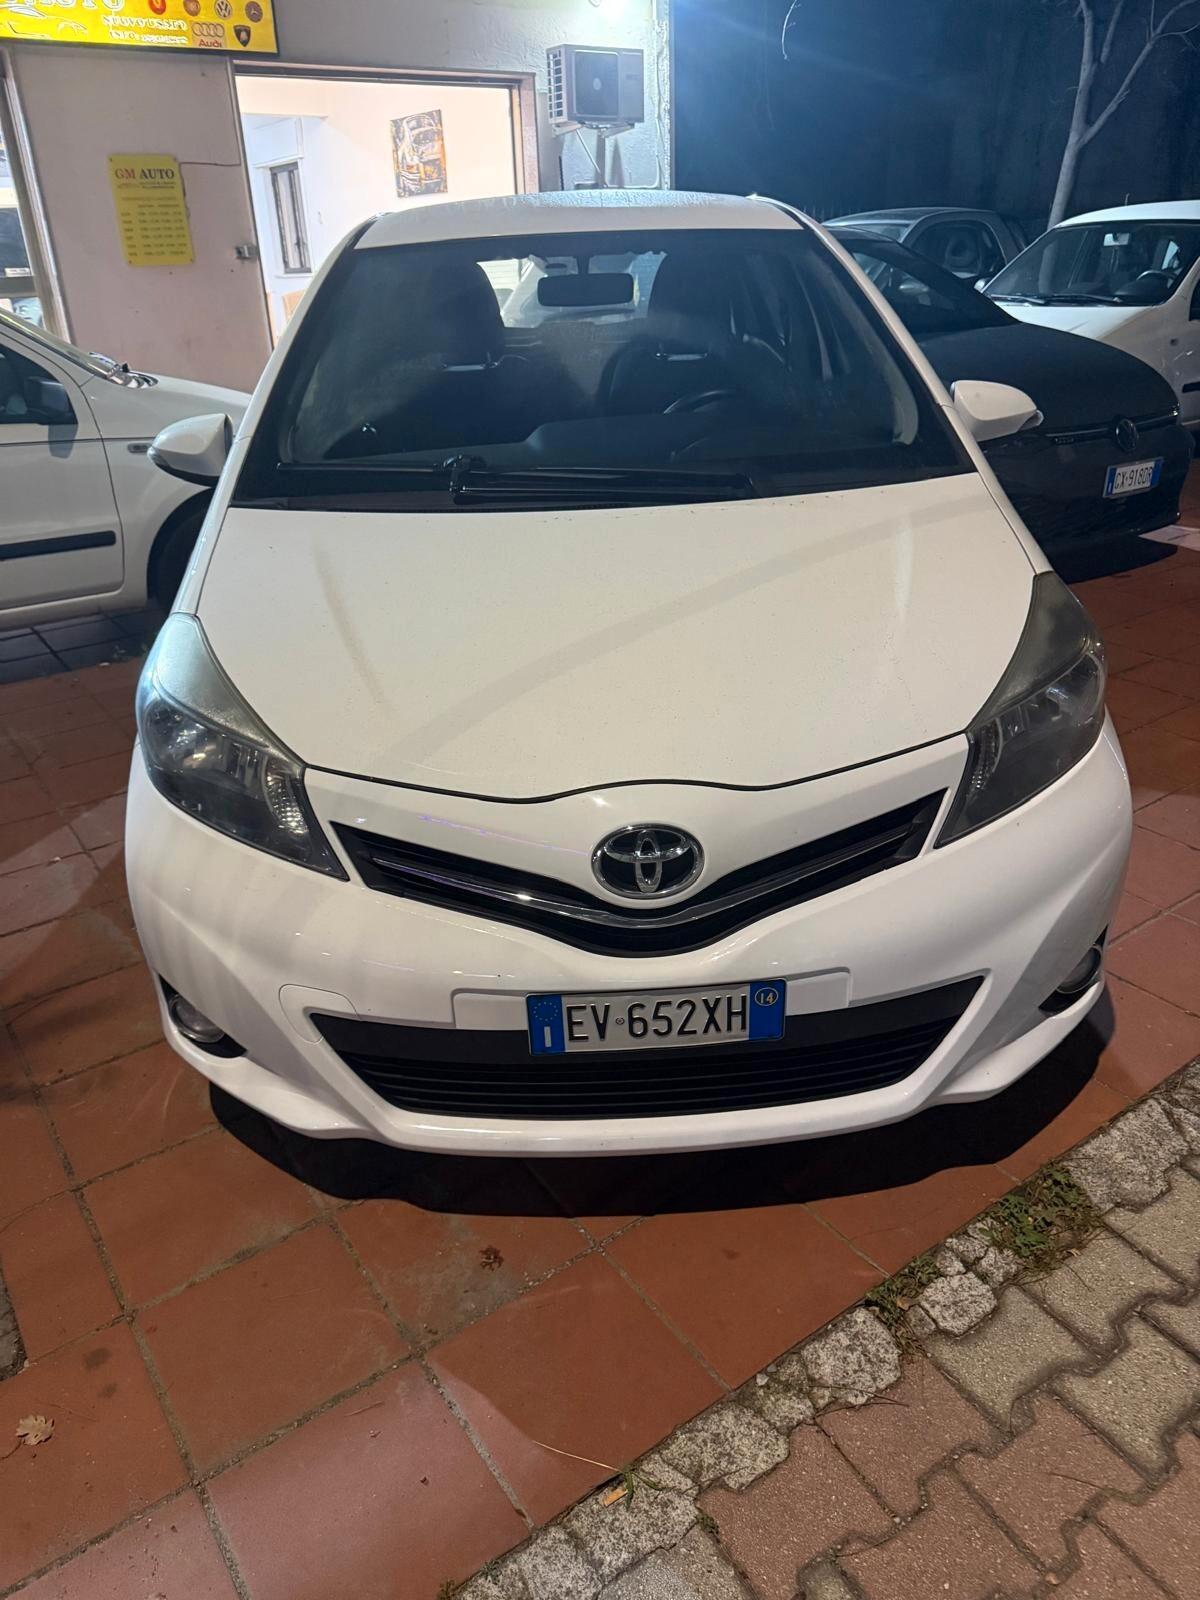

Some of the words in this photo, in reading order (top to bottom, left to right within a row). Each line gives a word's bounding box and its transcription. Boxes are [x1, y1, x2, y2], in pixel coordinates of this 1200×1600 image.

[198, 39, 223, 48] Audi
[114, 168, 136, 179] GM
[140, 168, 175, 179] AUTO
[760, 992, 774, 1003] 14
[566, 1003, 611, 1041] EV
[627, 994, 747, 1038] 652XH
